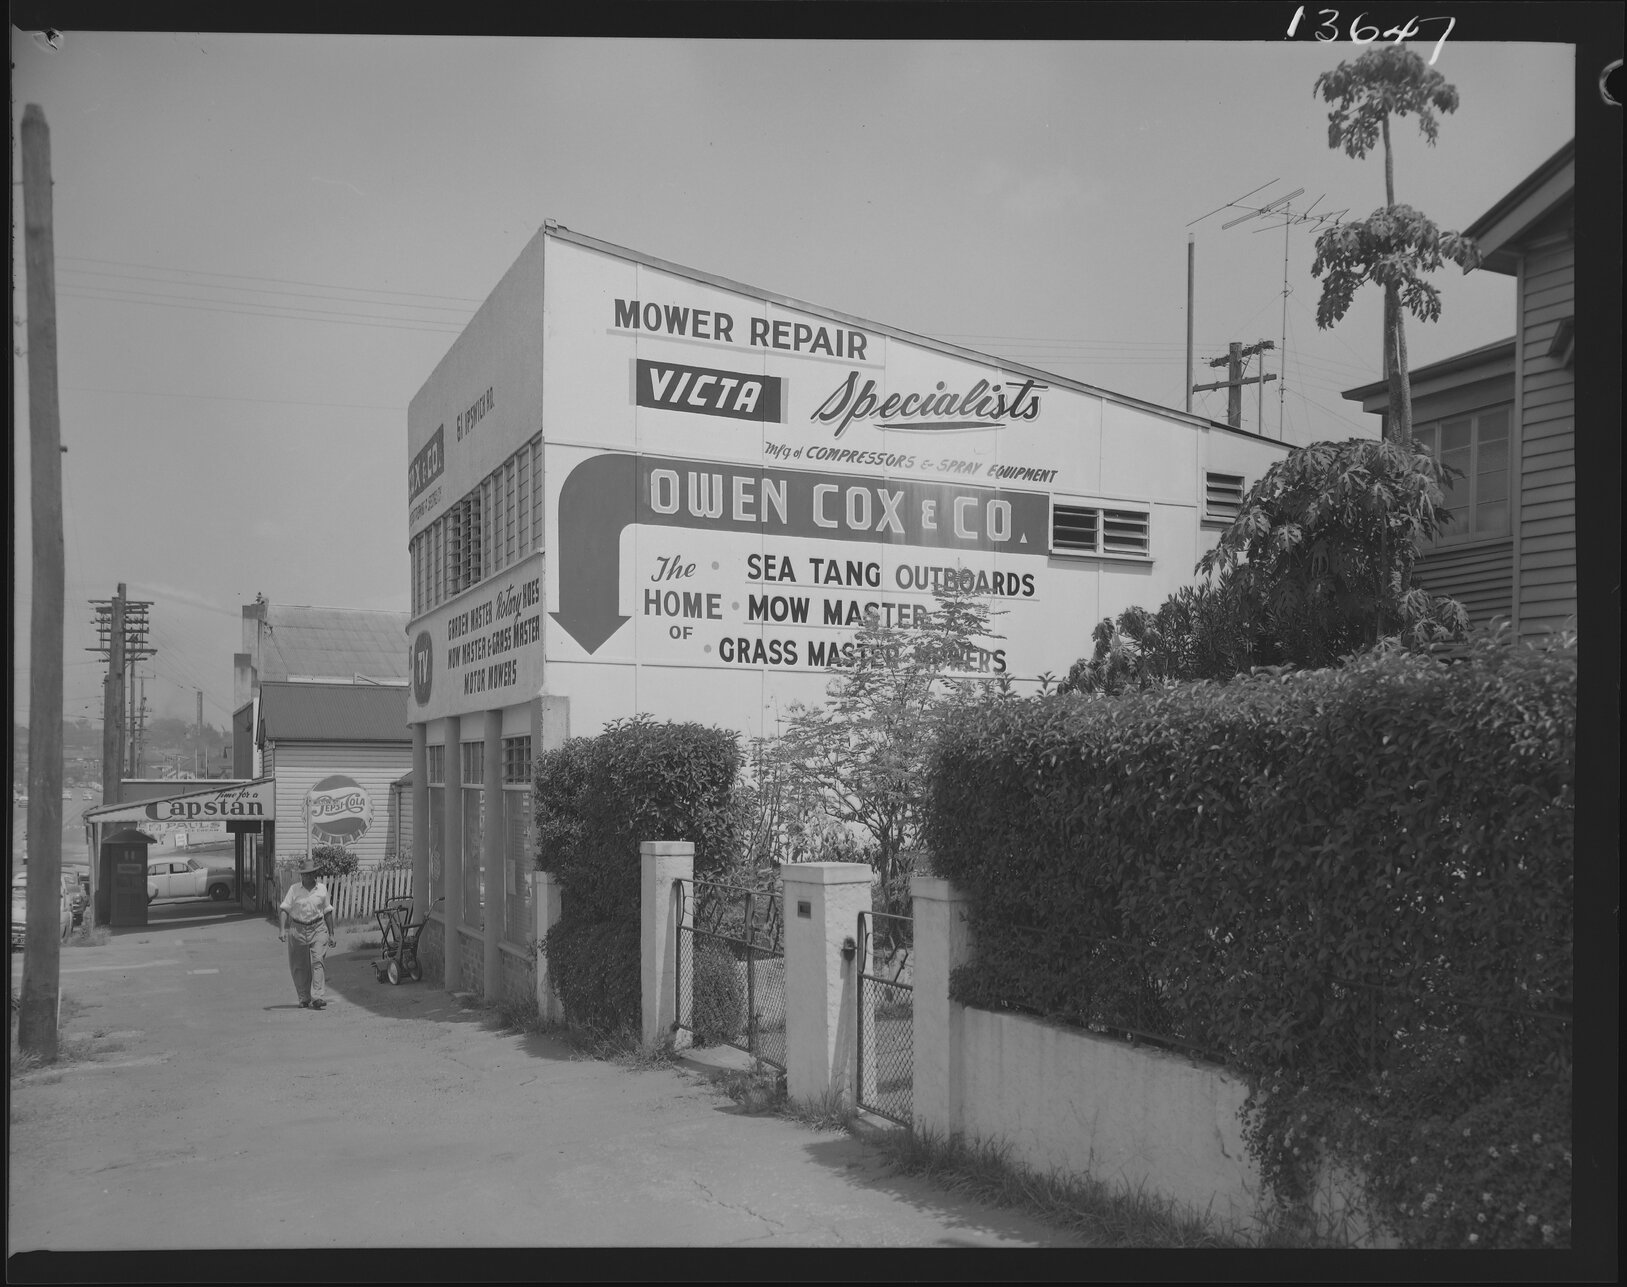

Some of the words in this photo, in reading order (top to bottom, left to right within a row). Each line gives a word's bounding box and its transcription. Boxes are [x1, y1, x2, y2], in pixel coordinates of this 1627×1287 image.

[614, 299, 734, 342] MOWER
[750, 317, 868, 361] REPAIR
[649, 367, 763, 413] VICTA
[810, 371, 1049, 437] Specialists
[806, 446, 917, 469] COMPRESSORS
[920, 459, 934, 470] &
[936, 459, 983, 476] SPRAY
[987, 464, 1058, 483] EQUIPMENT
[650, 468, 789, 525] OWEN
[812, 483, 906, 535] COX
[921, 499, 938, 530] &
[953, 495, 1028, 545] CO.
[650, 555, 698, 582] The
[747, 553, 797, 583] SEA
[809, 557, 882, 588] TANG
[895, 564, 1036, 597] OUTBOARDS
[448, 612, 468, 640] GARDEN
[471, 600, 492, 632] MASTER
[496, 584, 522, 624] Rotary
[522, 578, 540, 609] HOES
[644, 588, 723, 620] HOME
[748, 594, 809, 623] MOW
[824, 599, 928, 629] MASTER
[447, 646, 461, 670] MOW
[462, 637, 486, 666] MASTER
[493, 626, 512, 655] GRASS
[513, 615, 540, 649] MASTER
[669, 625, 694, 641] OF
[719, 637, 798, 666] GRASS
[808, 641, 900, 670] MASTER
[464, 669, 486, 696] MOTOR
[488, 659, 517, 690] MOWERS
[145, 799, 264, 820] Capstan
[215, 791, 238, 801] Time
[235, 788, 250, 801] for
